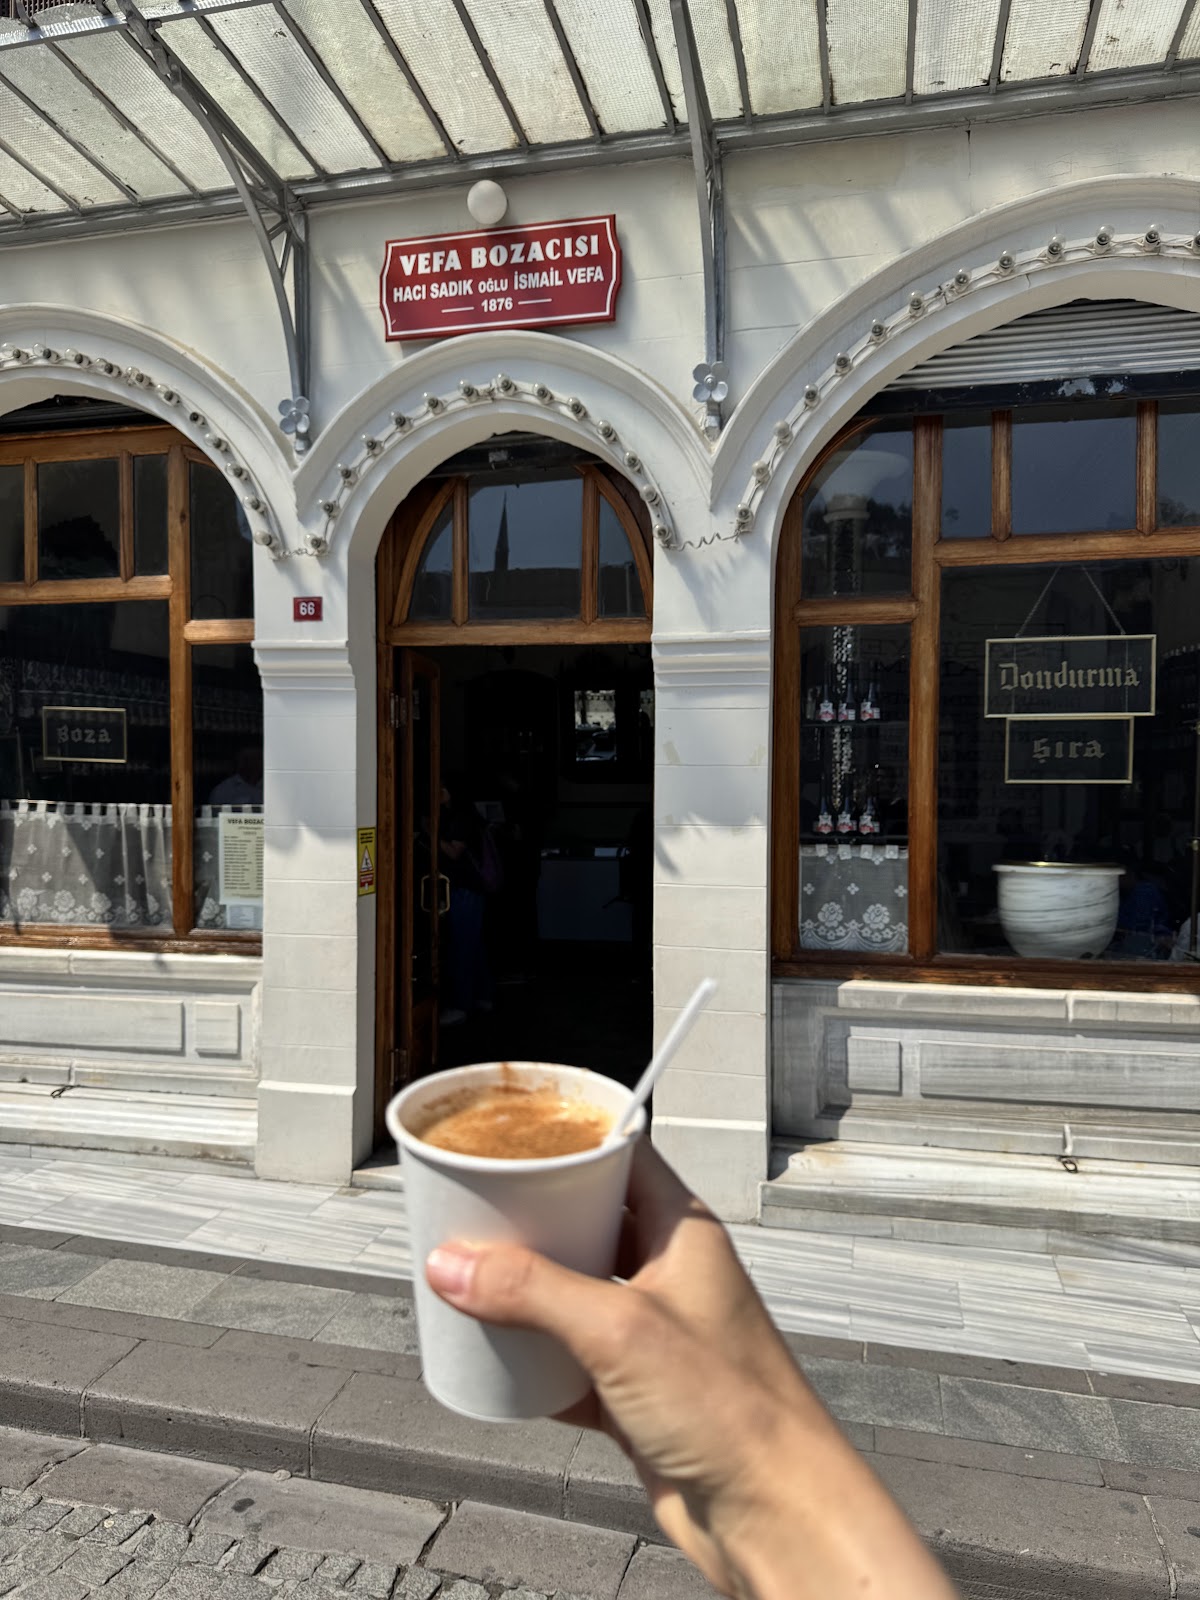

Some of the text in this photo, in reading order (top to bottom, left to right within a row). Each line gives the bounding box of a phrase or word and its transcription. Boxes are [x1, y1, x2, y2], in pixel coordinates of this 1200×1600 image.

[399, 234, 599, 276] VEFA BOZACISI
[393, 266, 604, 303] HACI SADIK OĞLU İSMAİL VEFA
[481, 297, 513, 313] 1876
[299, 601, 315, 616] 66
[998, 661, 1140, 691] Dondurma
[56, 723, 112, 744] Boza
